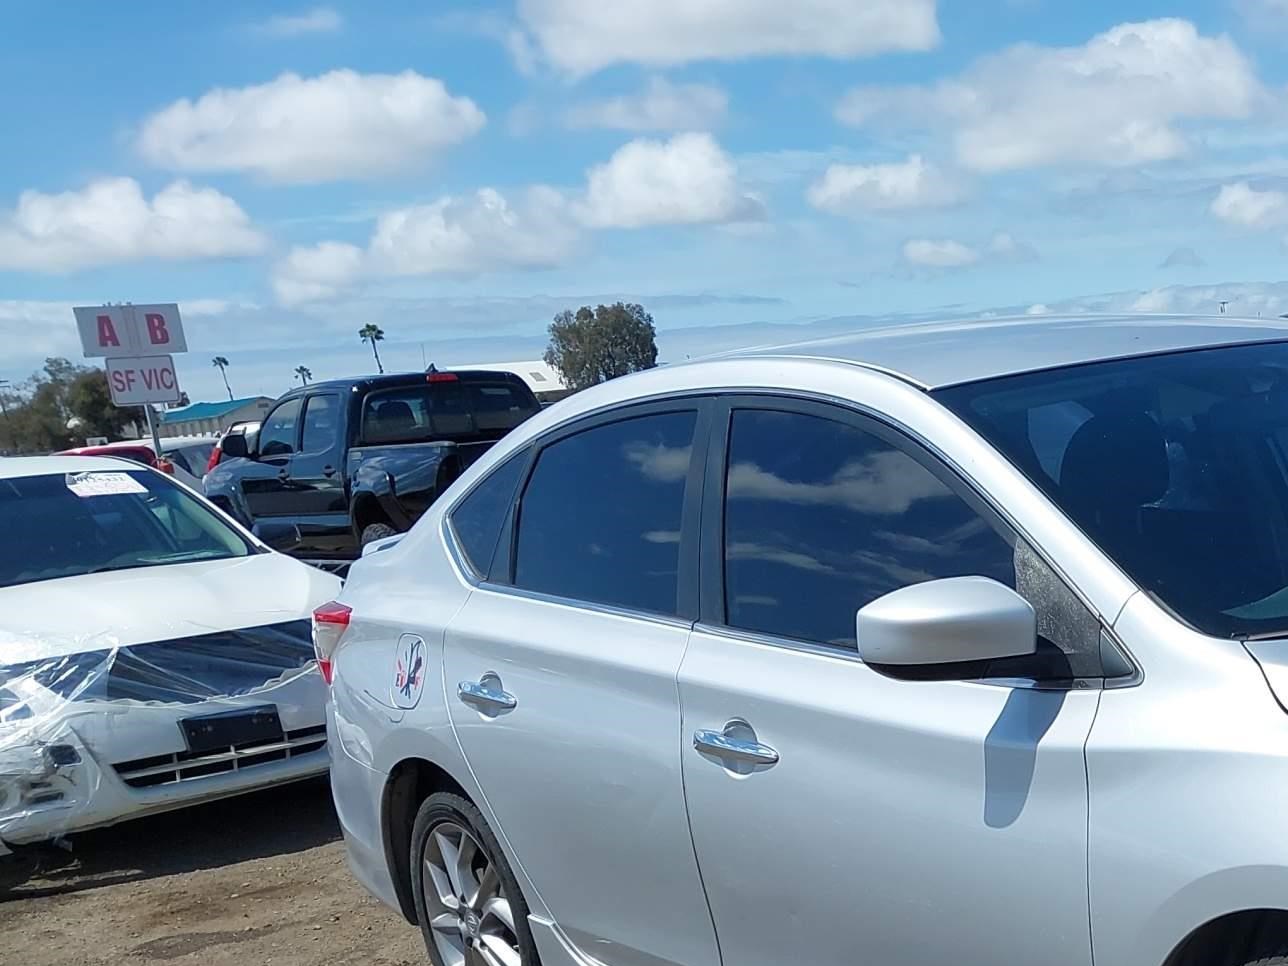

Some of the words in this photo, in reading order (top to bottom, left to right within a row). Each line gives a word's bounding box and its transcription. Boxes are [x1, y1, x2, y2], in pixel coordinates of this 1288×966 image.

[96, 315, 121, 347] A
[144, 313, 170, 345] B
[112, 369, 136, 393] SF
[140, 367, 174, 391] VIC
